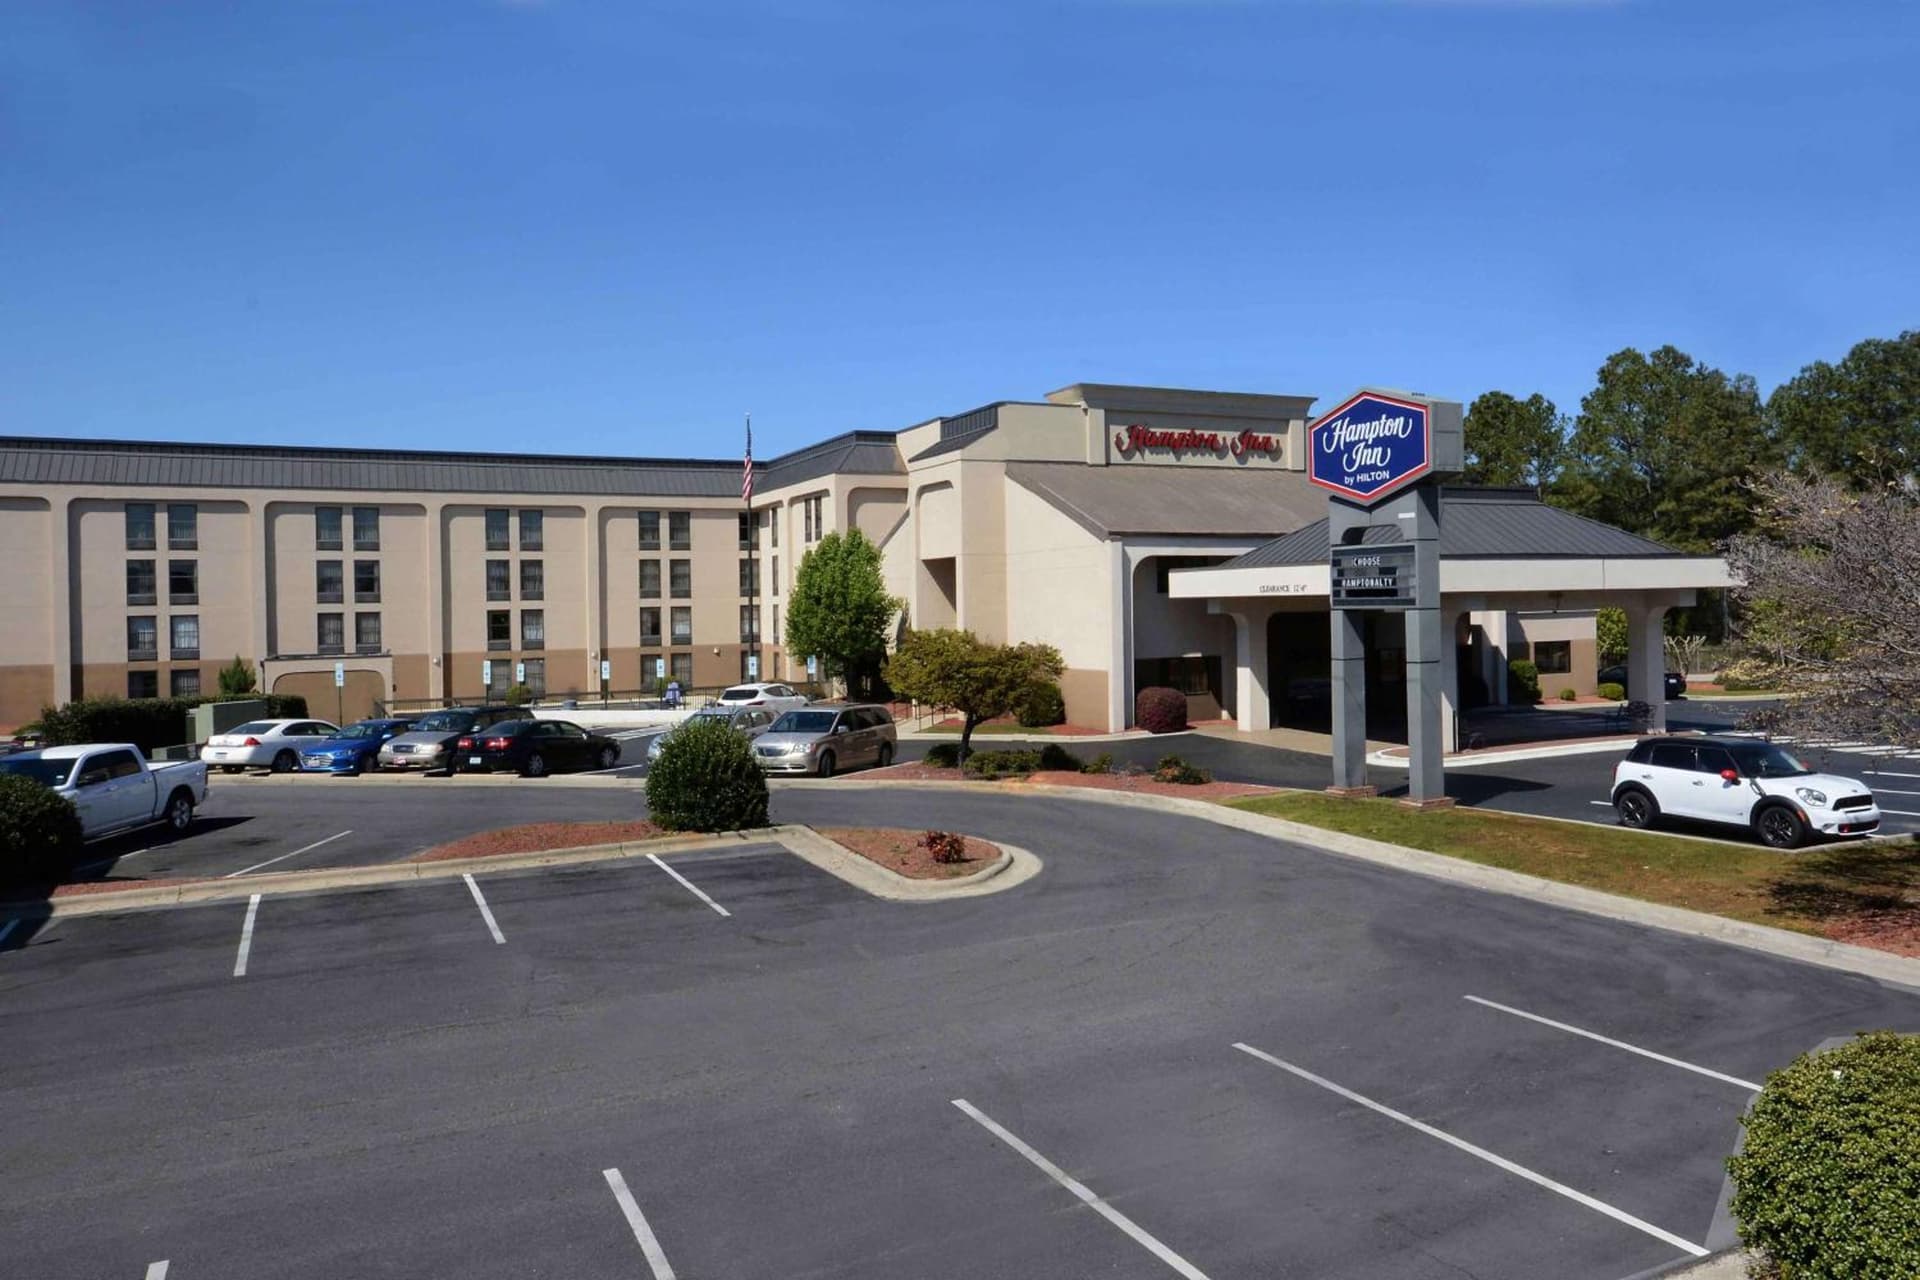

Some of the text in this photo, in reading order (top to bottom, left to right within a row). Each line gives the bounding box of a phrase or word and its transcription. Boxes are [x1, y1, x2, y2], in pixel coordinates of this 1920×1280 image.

[1115, 424, 1281, 457] Hampton Inn
[1324, 415, 1413, 453] Hampton
[1343, 444, 1391, 472] Inn
[1344, 470, 1390, 486] by HILTON
[1353, 556, 1380, 567] CHOOSE
